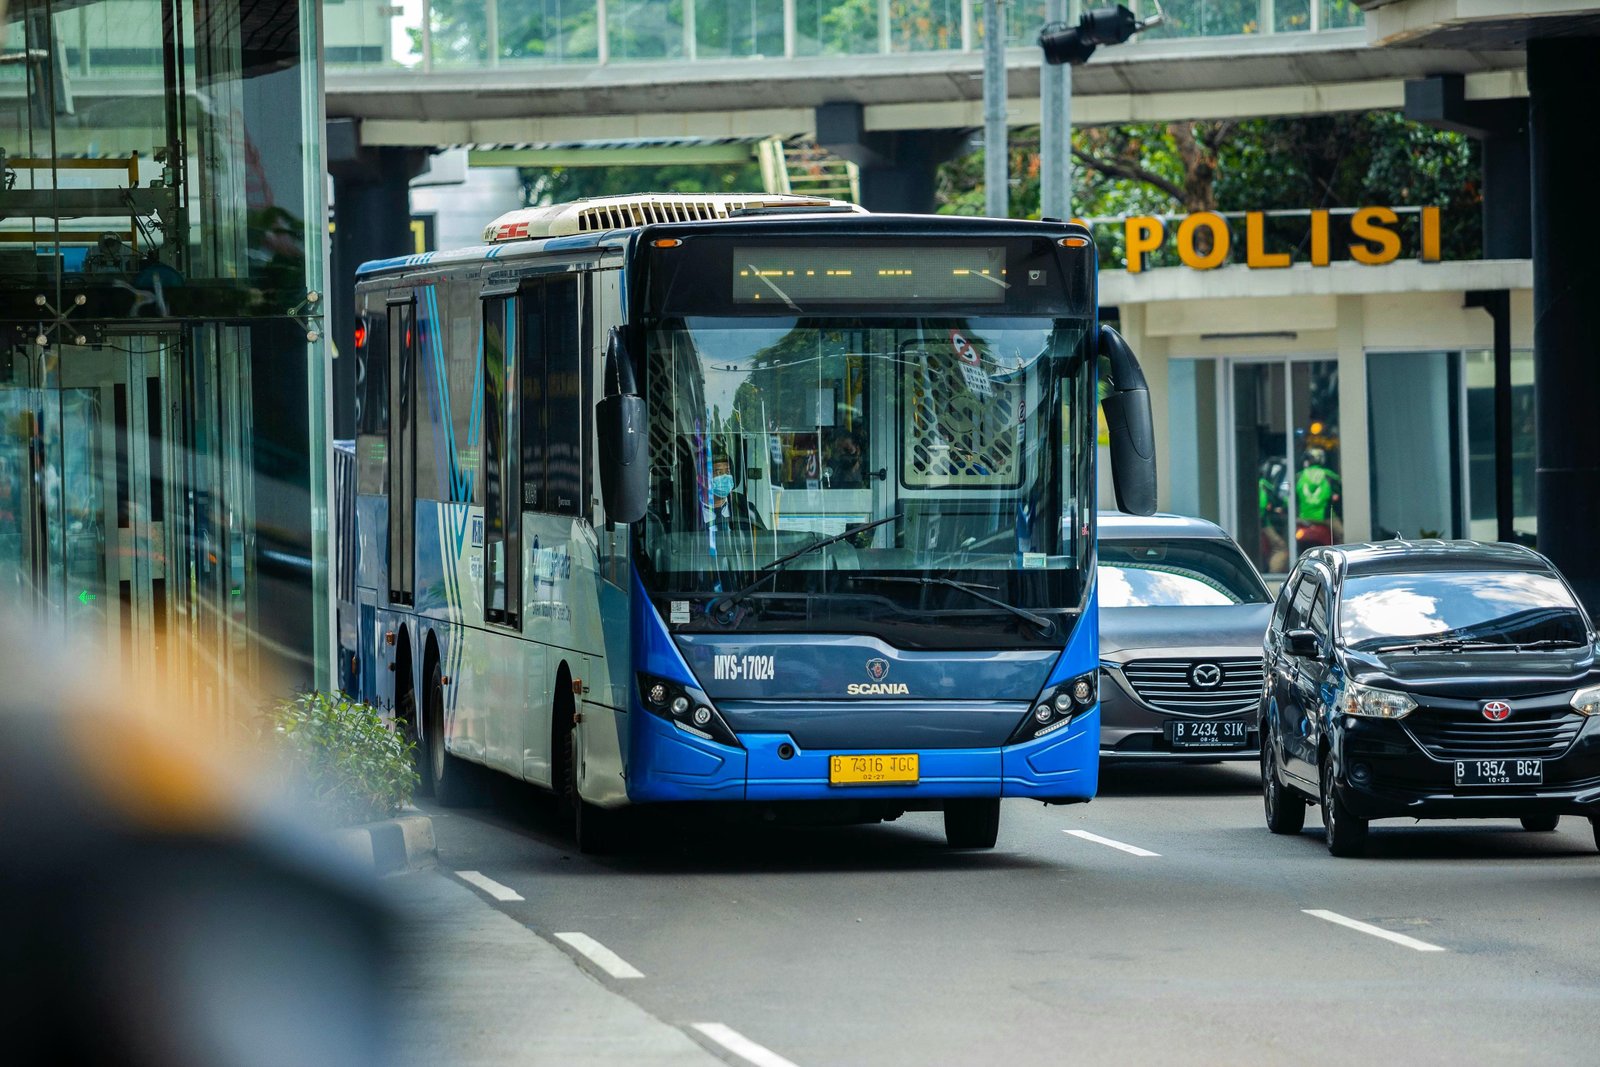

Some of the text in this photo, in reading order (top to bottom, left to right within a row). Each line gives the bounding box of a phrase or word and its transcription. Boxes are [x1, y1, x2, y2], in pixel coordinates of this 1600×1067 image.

[1125, 206, 1441, 274] POLISI
[714, 655, 775, 680] MYS-17024
[847, 683, 909, 695] SCANIA
[1177, 723, 1244, 736] B 2434 SIK
[833, 757, 915, 773] B 7316 TGC
[1456, 760, 1541, 777] B 1354 BGZ
